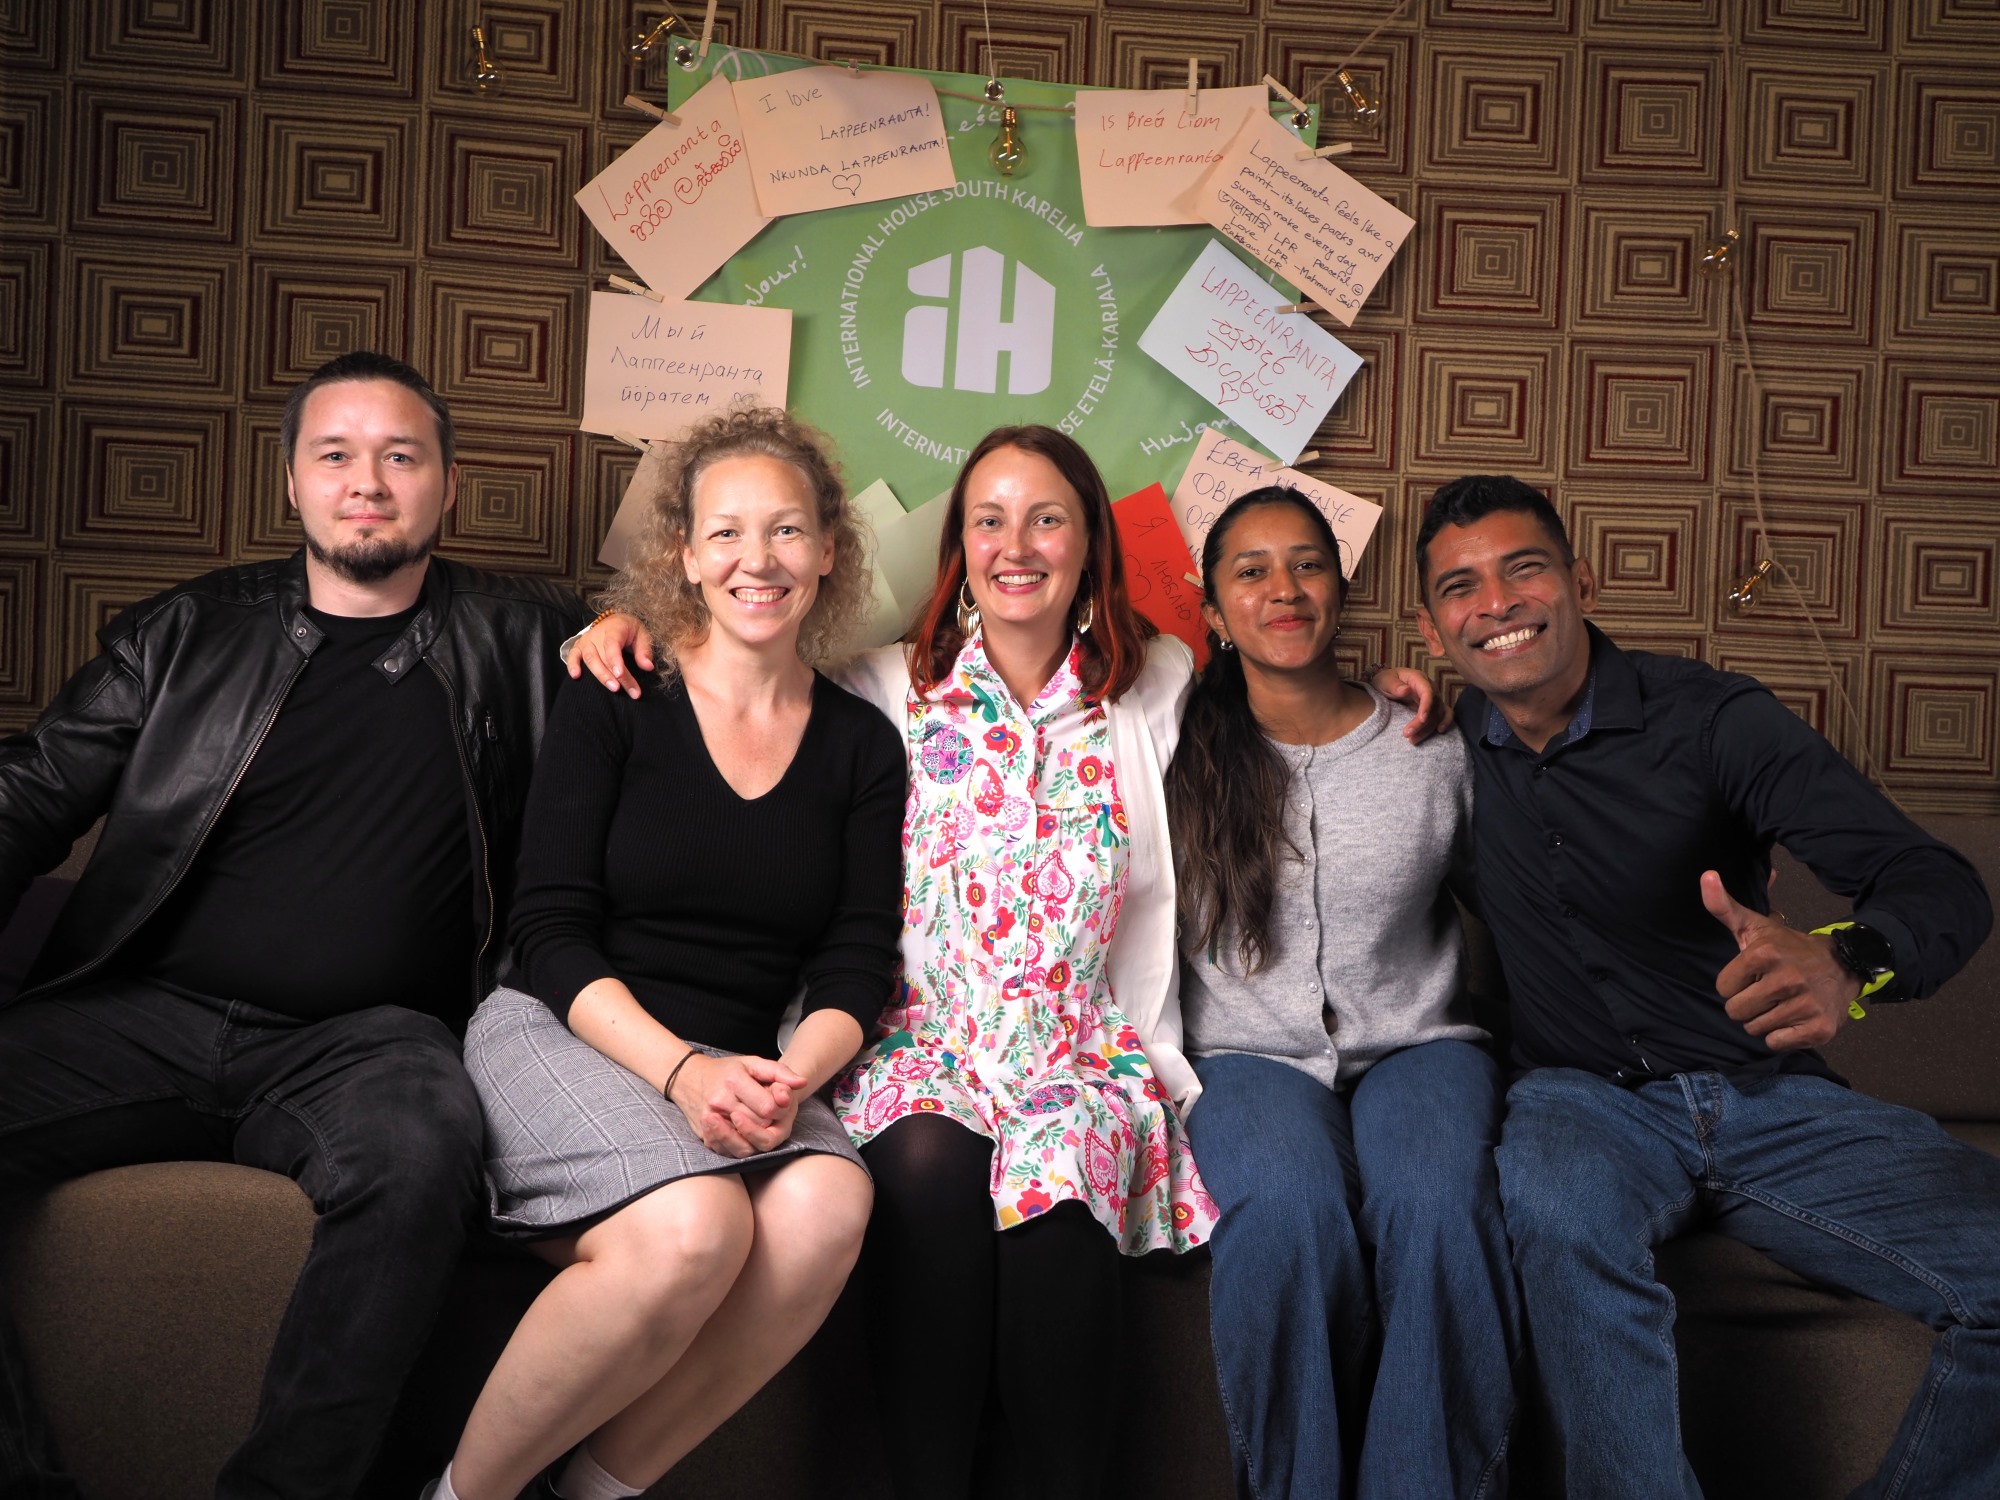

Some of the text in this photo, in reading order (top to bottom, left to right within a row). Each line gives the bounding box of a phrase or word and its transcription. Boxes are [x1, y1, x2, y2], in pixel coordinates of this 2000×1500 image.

[759, 87, 823, 112] I love
[820, 103, 931, 141] LAPPEENRANTA!
[598, 120, 721, 222] Lappeenranta
[769, 137, 945, 184] NKUNDA LAPPEENRANTA!
[1230, 180, 1357, 276] sunsets make every day
[1230, 216, 1289, 265] Love LPR
[1274, 232, 1299, 254] LPR
[1334, 200, 1359, 226] feels
[1360, 219, 1382, 242] like
[1386, 240, 1396, 254] a
[742, 244, 806, 306] njour!
[1264, 254, 1283, 271] LPR
[1357, 246, 1382, 263] and
[840, 180, 1085, 389] INTERNATIONAL HOUSE SOUTH KARELIA
[631, 315, 708, 340] Мый
[1077, 263, 1119, 416] ETELÄ-KARJALA
[1201, 266, 1337, 392] LAPPEENRANTA
[611, 346, 763, 385] Лаппеенранта
[876, 408, 973, 465] INTERNAT
[1151, 559, 1191, 621] ЛЮБЛЮ
